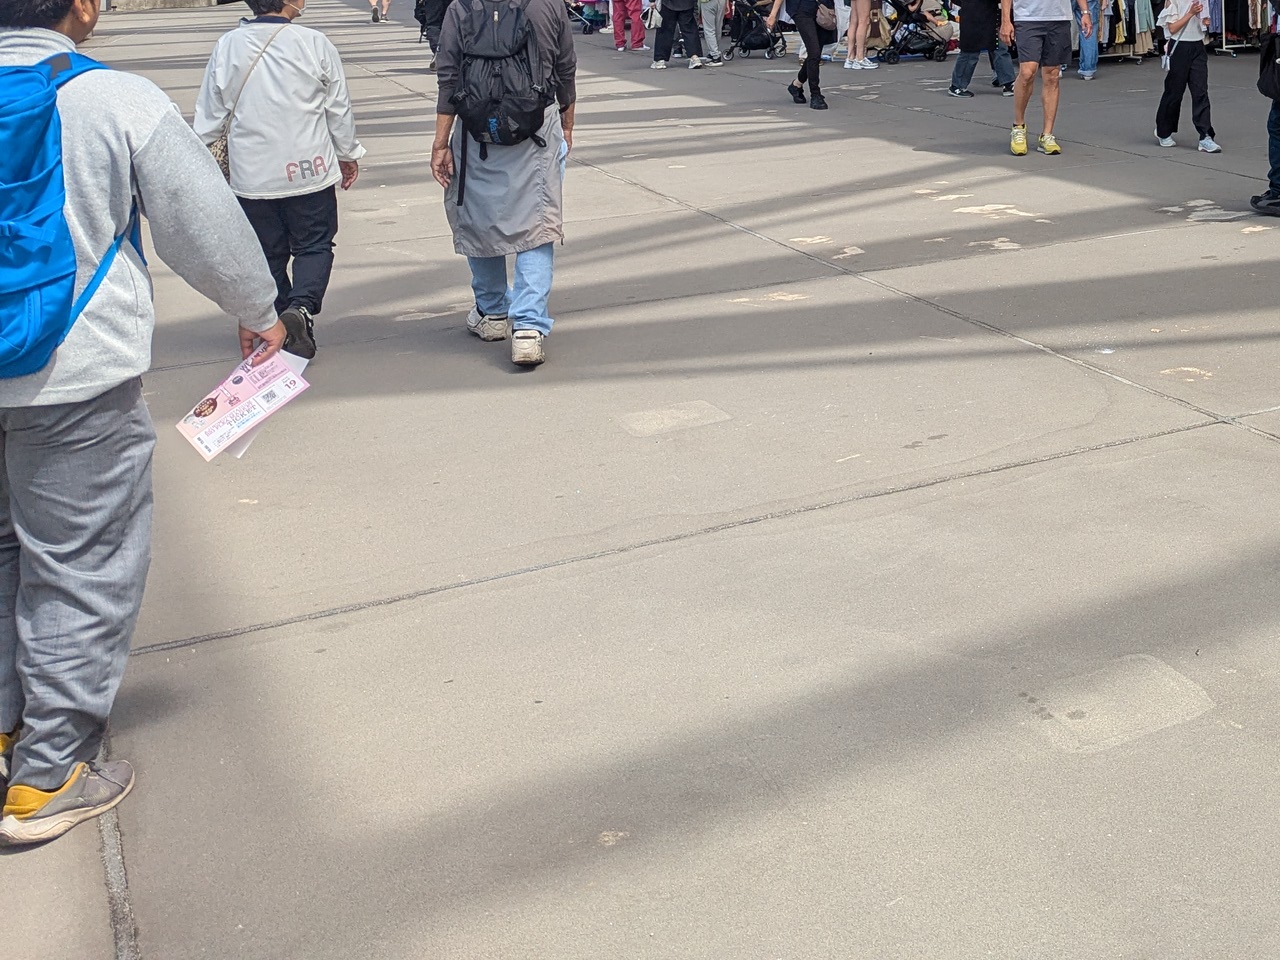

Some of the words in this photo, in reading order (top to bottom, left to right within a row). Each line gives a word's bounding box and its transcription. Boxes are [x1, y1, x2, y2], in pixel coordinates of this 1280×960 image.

[285, 155, 328, 182] FRA
[284, 379, 297, 390] 19
[226, 404, 257, 427] TICKET
